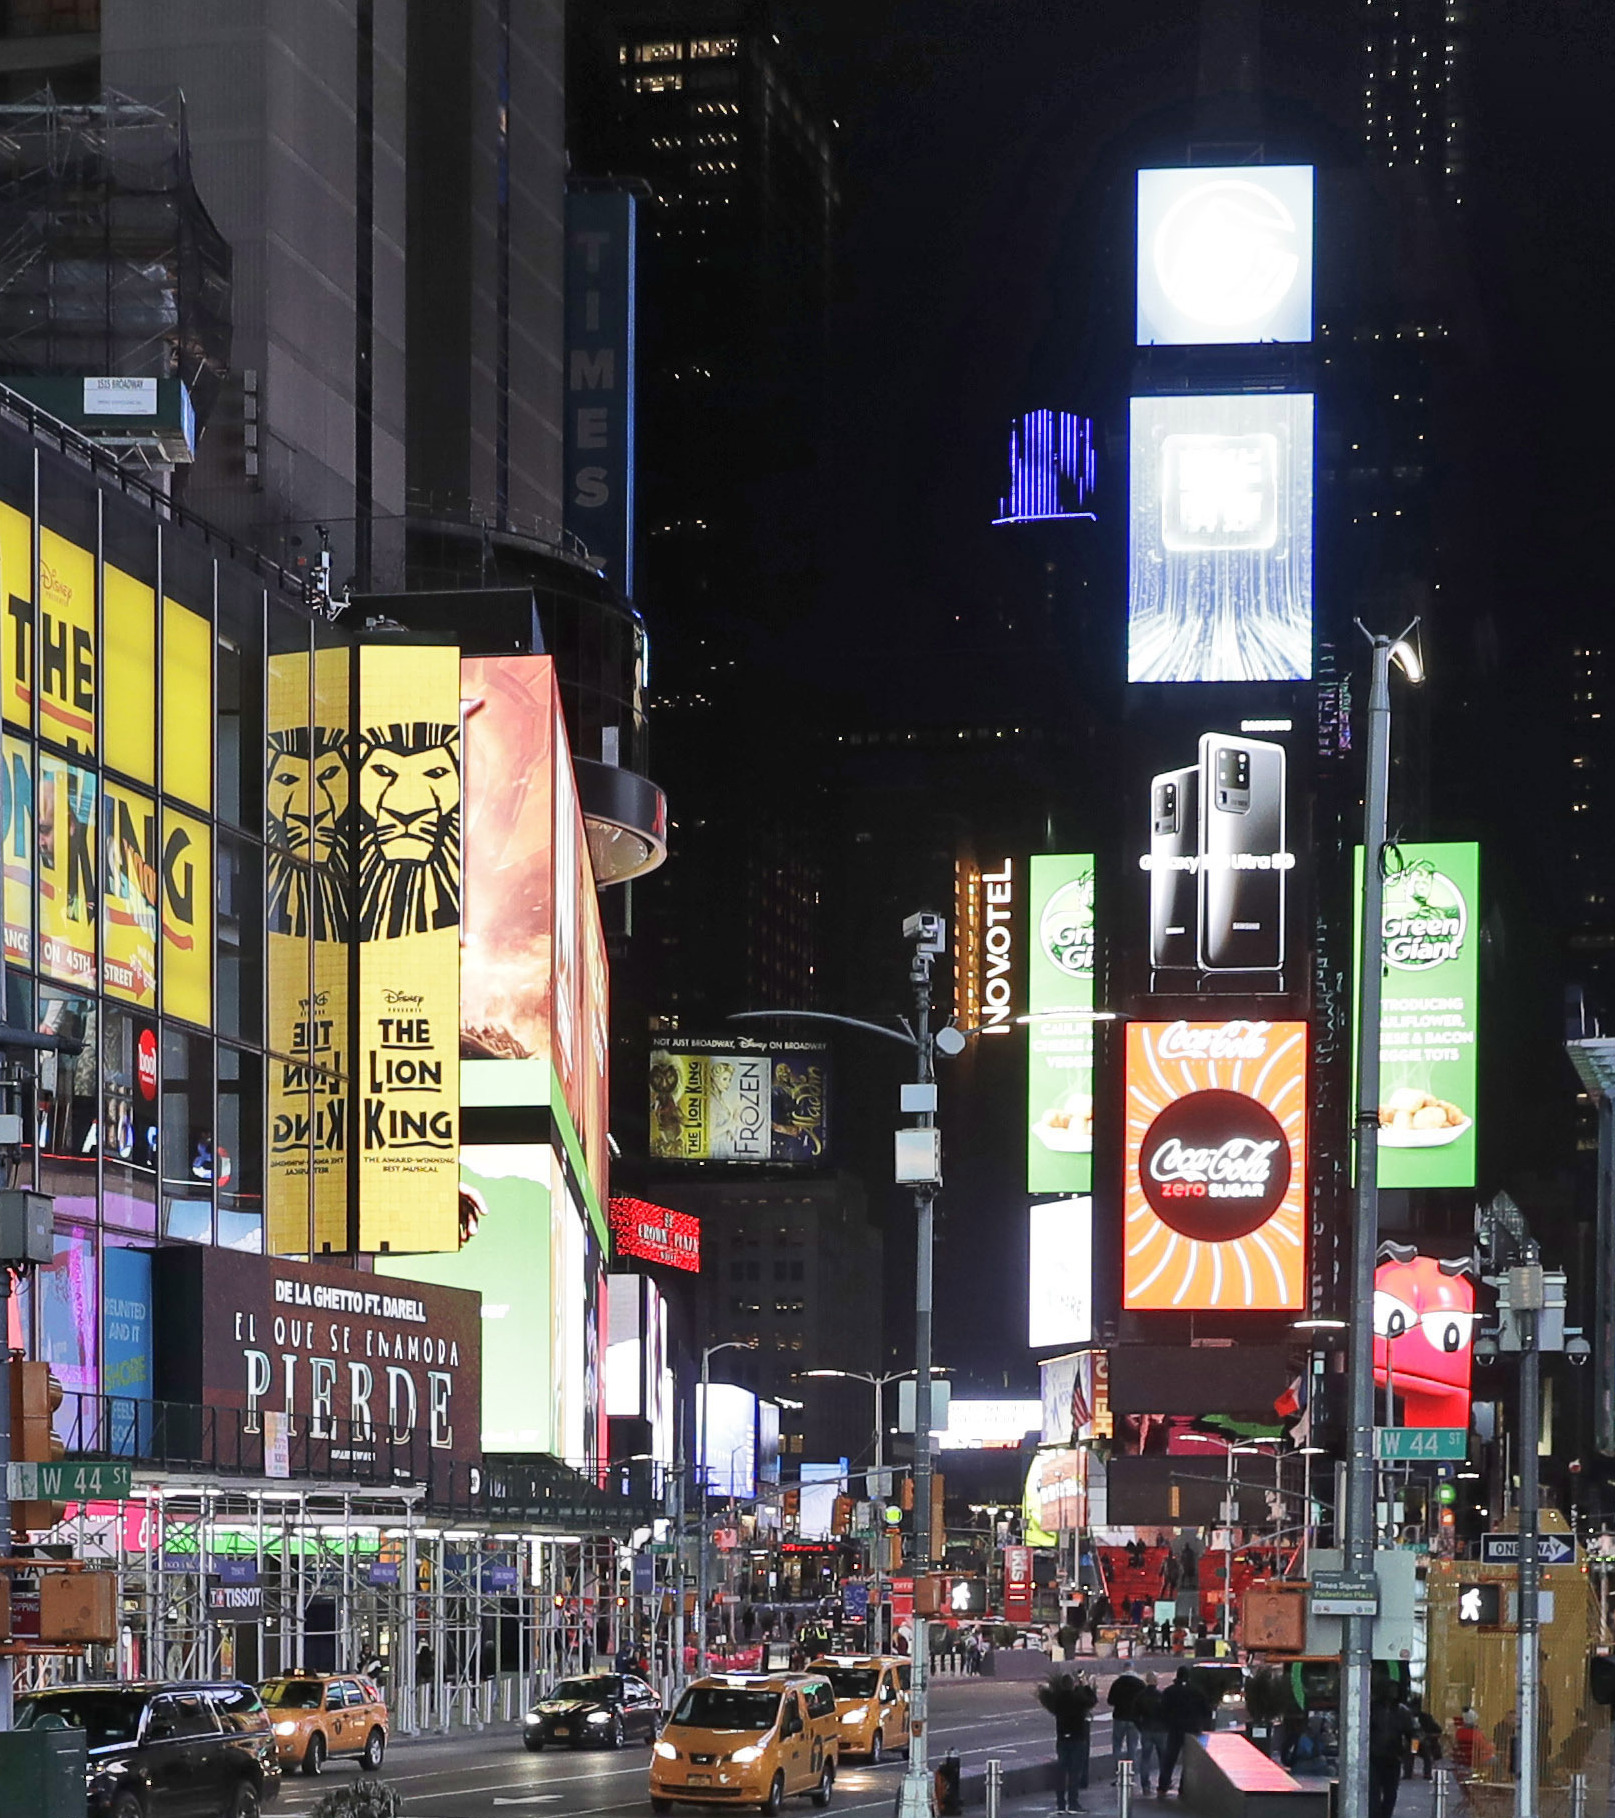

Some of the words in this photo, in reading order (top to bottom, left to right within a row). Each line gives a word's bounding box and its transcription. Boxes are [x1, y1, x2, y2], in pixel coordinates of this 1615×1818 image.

[570, 231, 616, 508] TIMES
[7, 593, 94, 714] THE
[66, 735, 194, 928] KING
[1382, 914, 1460, 938] Green
[981, 857, 1012, 1034] NOVOTEL
[1386, 936, 1464, 961] Giant
[43, 939, 62, 965] ON
[65, 946, 92, 975] 45TH
[103, 960, 134, 989] STREET
[382, 988, 425, 1007] Disney
[1381, 997, 1464, 1011] TRODUCING
[378, 1018, 431, 1043] THE
[1380, 1014, 1466, 1029] ULIFLOWER,
[653, 1037, 671, 1046] NOT
[672, 1038, 690, 1048] JUST
[691, 1038, 736, 1050] BROADWAY,
[736, 1035, 768, 1052] Disney
[769, 1041, 783, 1050] ON
[784, 1041, 827, 1051] BROADWAY
[1380, 1048, 1422, 1063] EGGIE
[369, 1050, 442, 1094] LION
[684, 1061, 702, 1094] KING
[684, 1094, 702, 1129] LION
[735, 1061, 766, 1157] FROZEN
[363, 1097, 453, 1151] KING
[687, 1130, 702, 1155] THE
[1150, 1138, 1282, 1182] Coca-Cola
[1161, 1183, 1207, 1198] zero
[1207, 1183, 1265, 1198] SUGAR
[275, 1279, 293, 1304] DE
[294, 1282, 314, 1305] LA
[313, 1285, 363, 1314] GHETTO
[364, 1293, 382, 1316] FT.
[382, 1297, 427, 1324] DARELL
[108, 1321, 131, 1342] AND
[131, 1325, 141, 1343] IT
[234, 1311, 256, 1342] EL
[273, 1316, 315, 1350] QUE
[329, 1323, 352, 1354] SE
[365, 1329, 460, 1367] ENAMORA
[243, 1348, 454, 1451] PIERDE
[1384, 1434, 1401, 1454] W
[1409, 1433, 1439, 1456] 44
[1448, 1431, 1462, 1447] ST
[42, 1467, 63, 1495] W
[73, 1466, 102, 1495] 44
[112, 1465, 129, 1486] St
[225, 1586, 262, 1608] TISSOT
[1314, 1580, 1338, 1590] Times
[1339, 1580, 1367, 1591] Square
[1314, 1590, 1353, 1599] Pedestrian
[1353, 1590, 1374, 1599] Plaza
